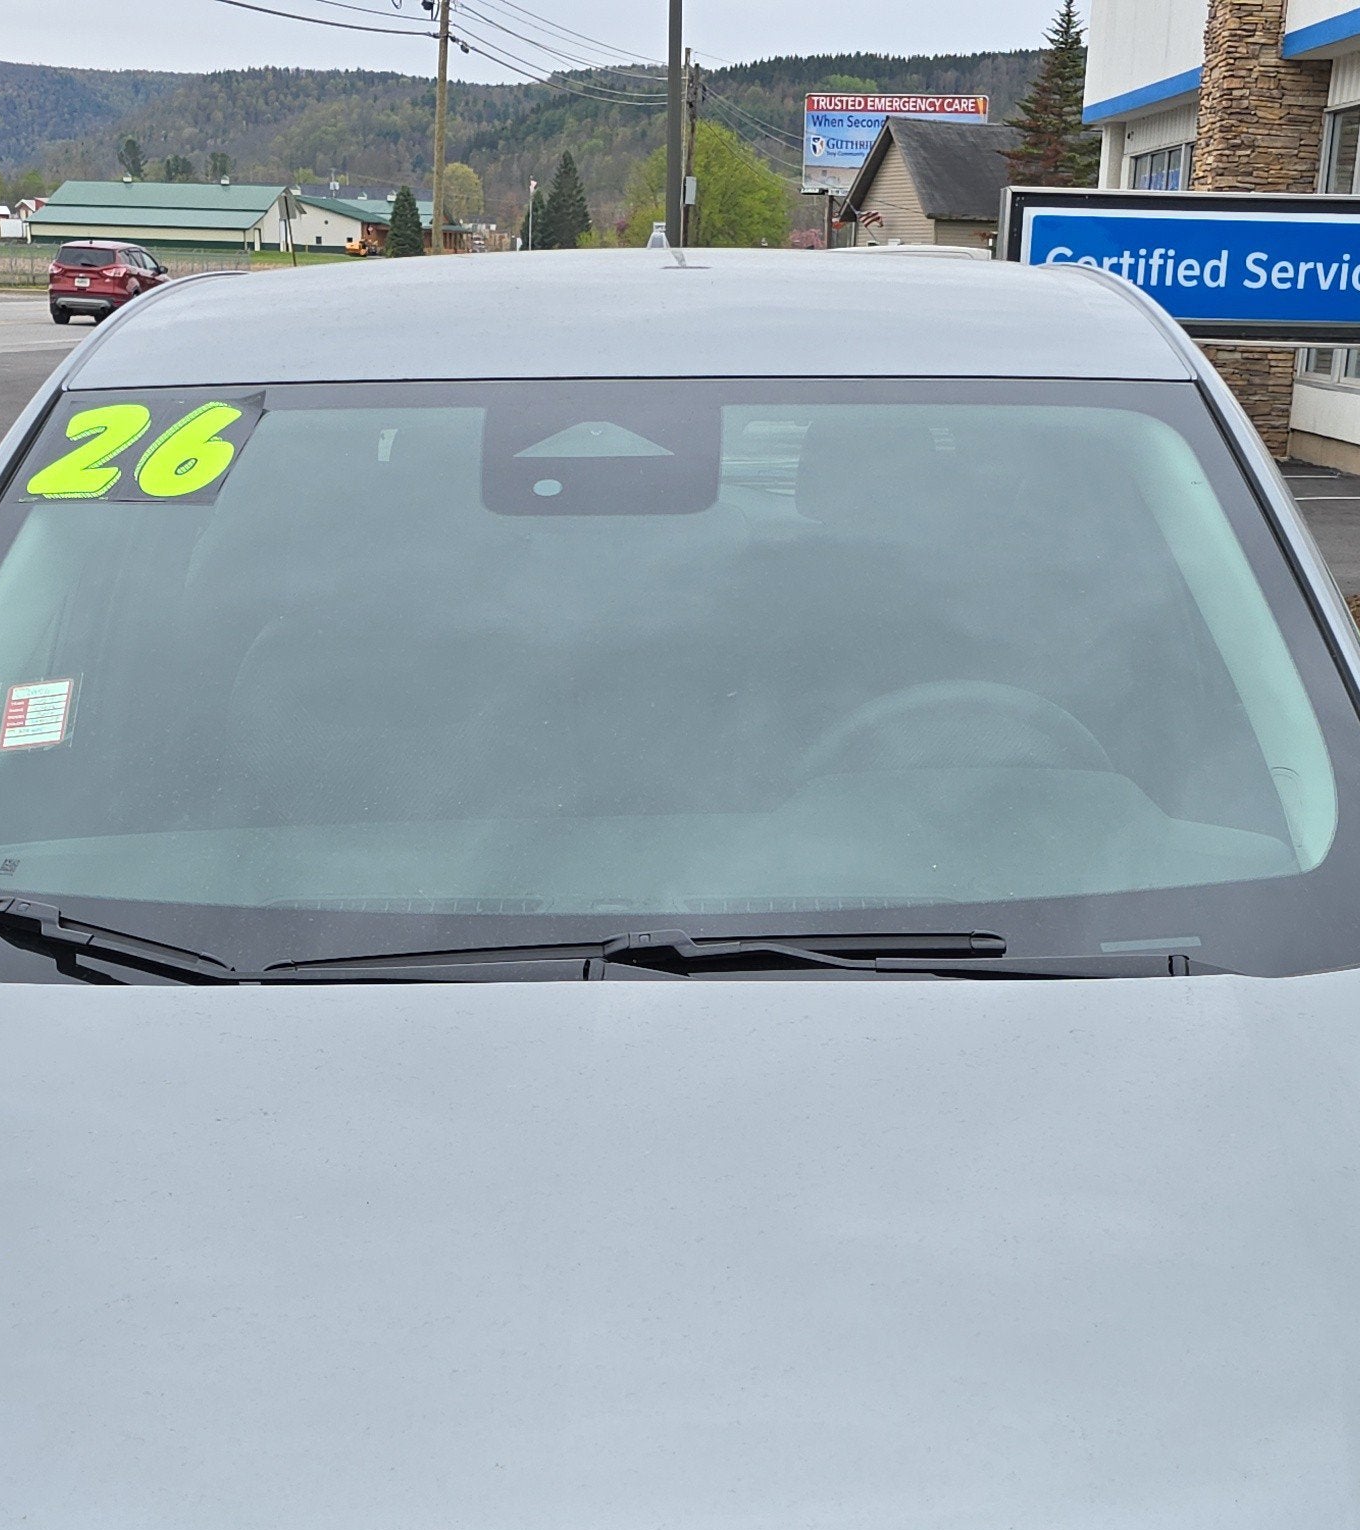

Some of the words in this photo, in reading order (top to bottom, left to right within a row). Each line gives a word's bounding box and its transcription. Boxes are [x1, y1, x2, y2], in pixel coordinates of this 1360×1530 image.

[811, 96, 865, 110] TRUSTED
[867, 97, 942, 112] EMERGENCY
[943, 98, 976, 112] CARE
[811, 114, 844, 127] When
[26, 401, 243, 498] 26
